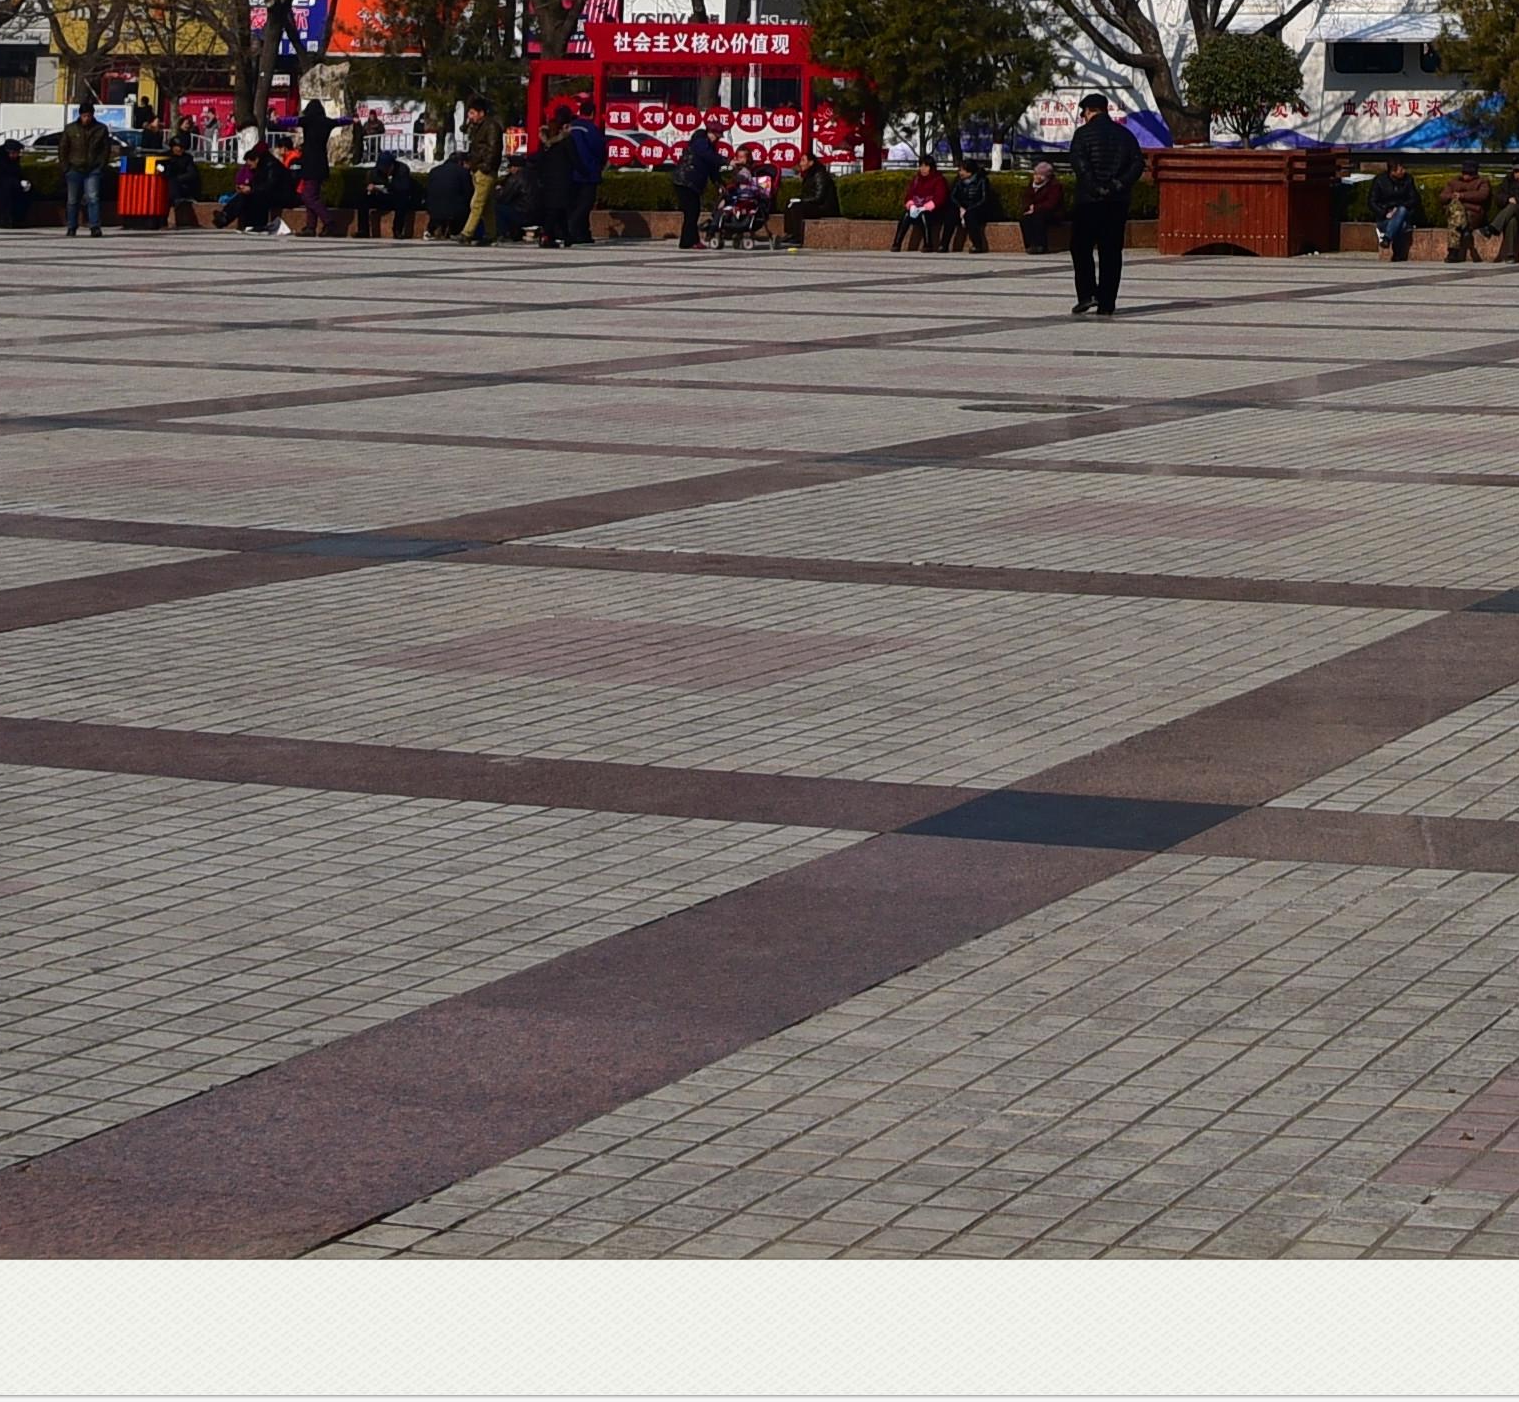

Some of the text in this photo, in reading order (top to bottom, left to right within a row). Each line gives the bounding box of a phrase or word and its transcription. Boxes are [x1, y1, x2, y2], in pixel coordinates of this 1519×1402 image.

[613, 31, 791, 56] 社会主义核心价值观
[1342, 99, 1445, 119] 血浓情更浓
[609, 111, 632, 125] 富强
[642, 111, 666, 126] 文明
[673, 111, 697, 126] 自由
[739, 112, 764, 127] 爱国
[608, 145, 631, 159] 民主
[640, 145, 664, 160] 和谐
[771, 146, 796, 162] 友善
